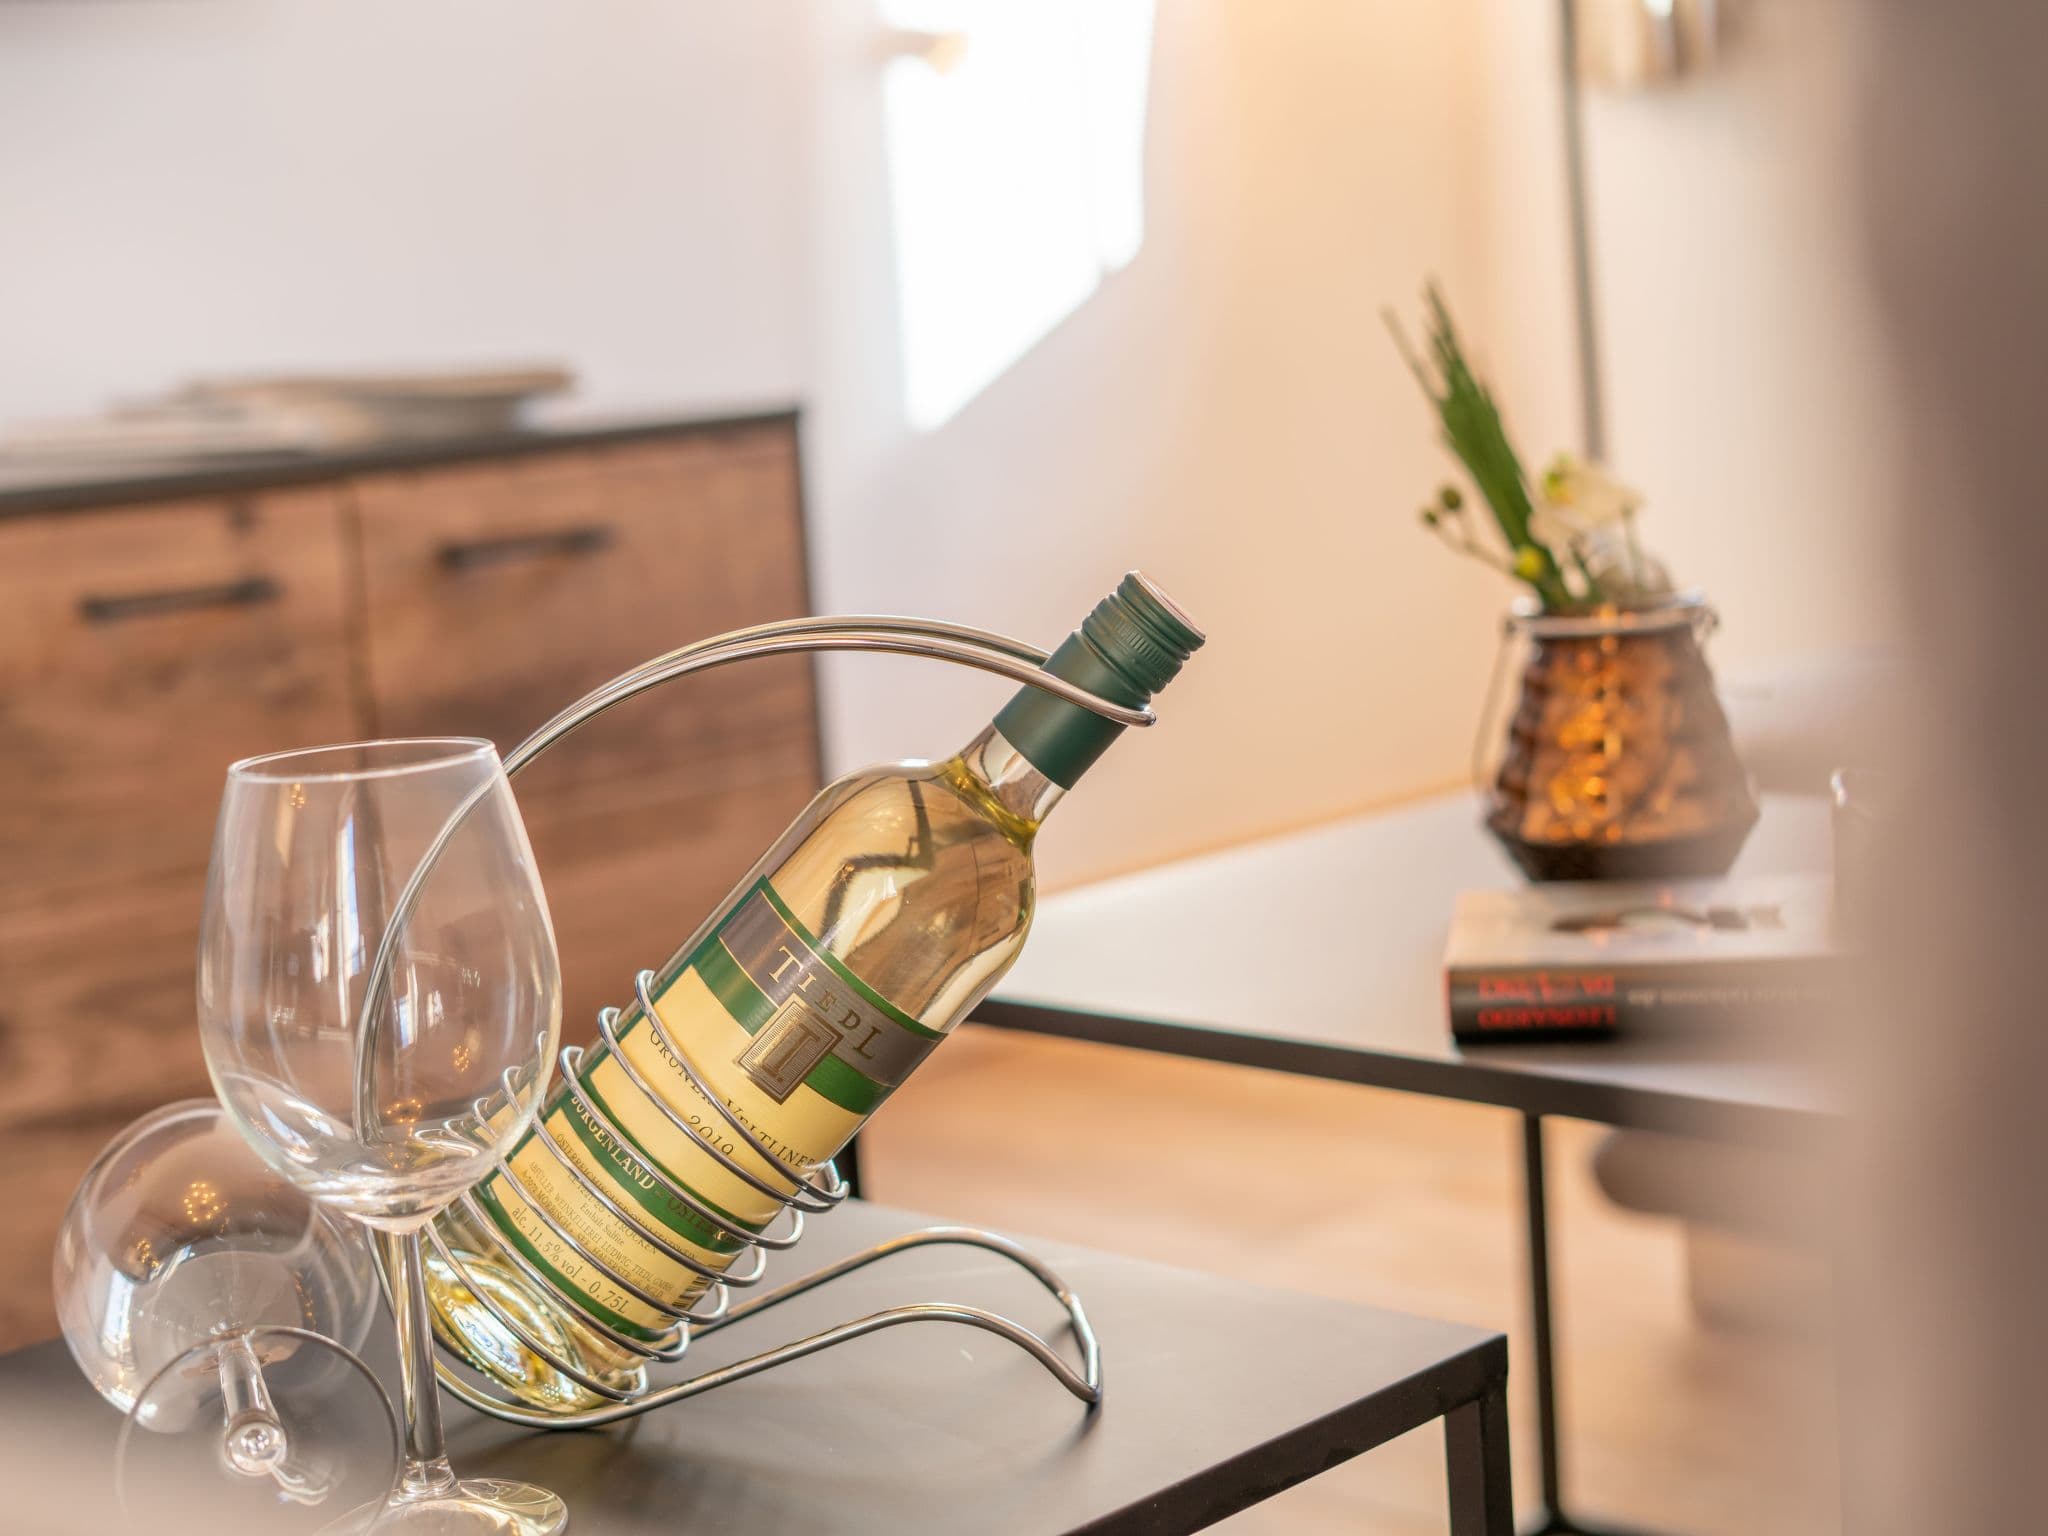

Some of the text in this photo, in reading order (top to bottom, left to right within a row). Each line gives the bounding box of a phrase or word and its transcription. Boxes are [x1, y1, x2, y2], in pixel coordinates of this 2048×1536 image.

[768, 945, 882, 1060] TIEDL
[570, 1095, 656, 1190] BURGENLAND
[511, 1207, 528, 1229] alc.
[528, 1226, 562, 1262] 11.5%
[561, 1259, 583, 1279] vol
[588, 1281, 629, 1314] 0.75L
